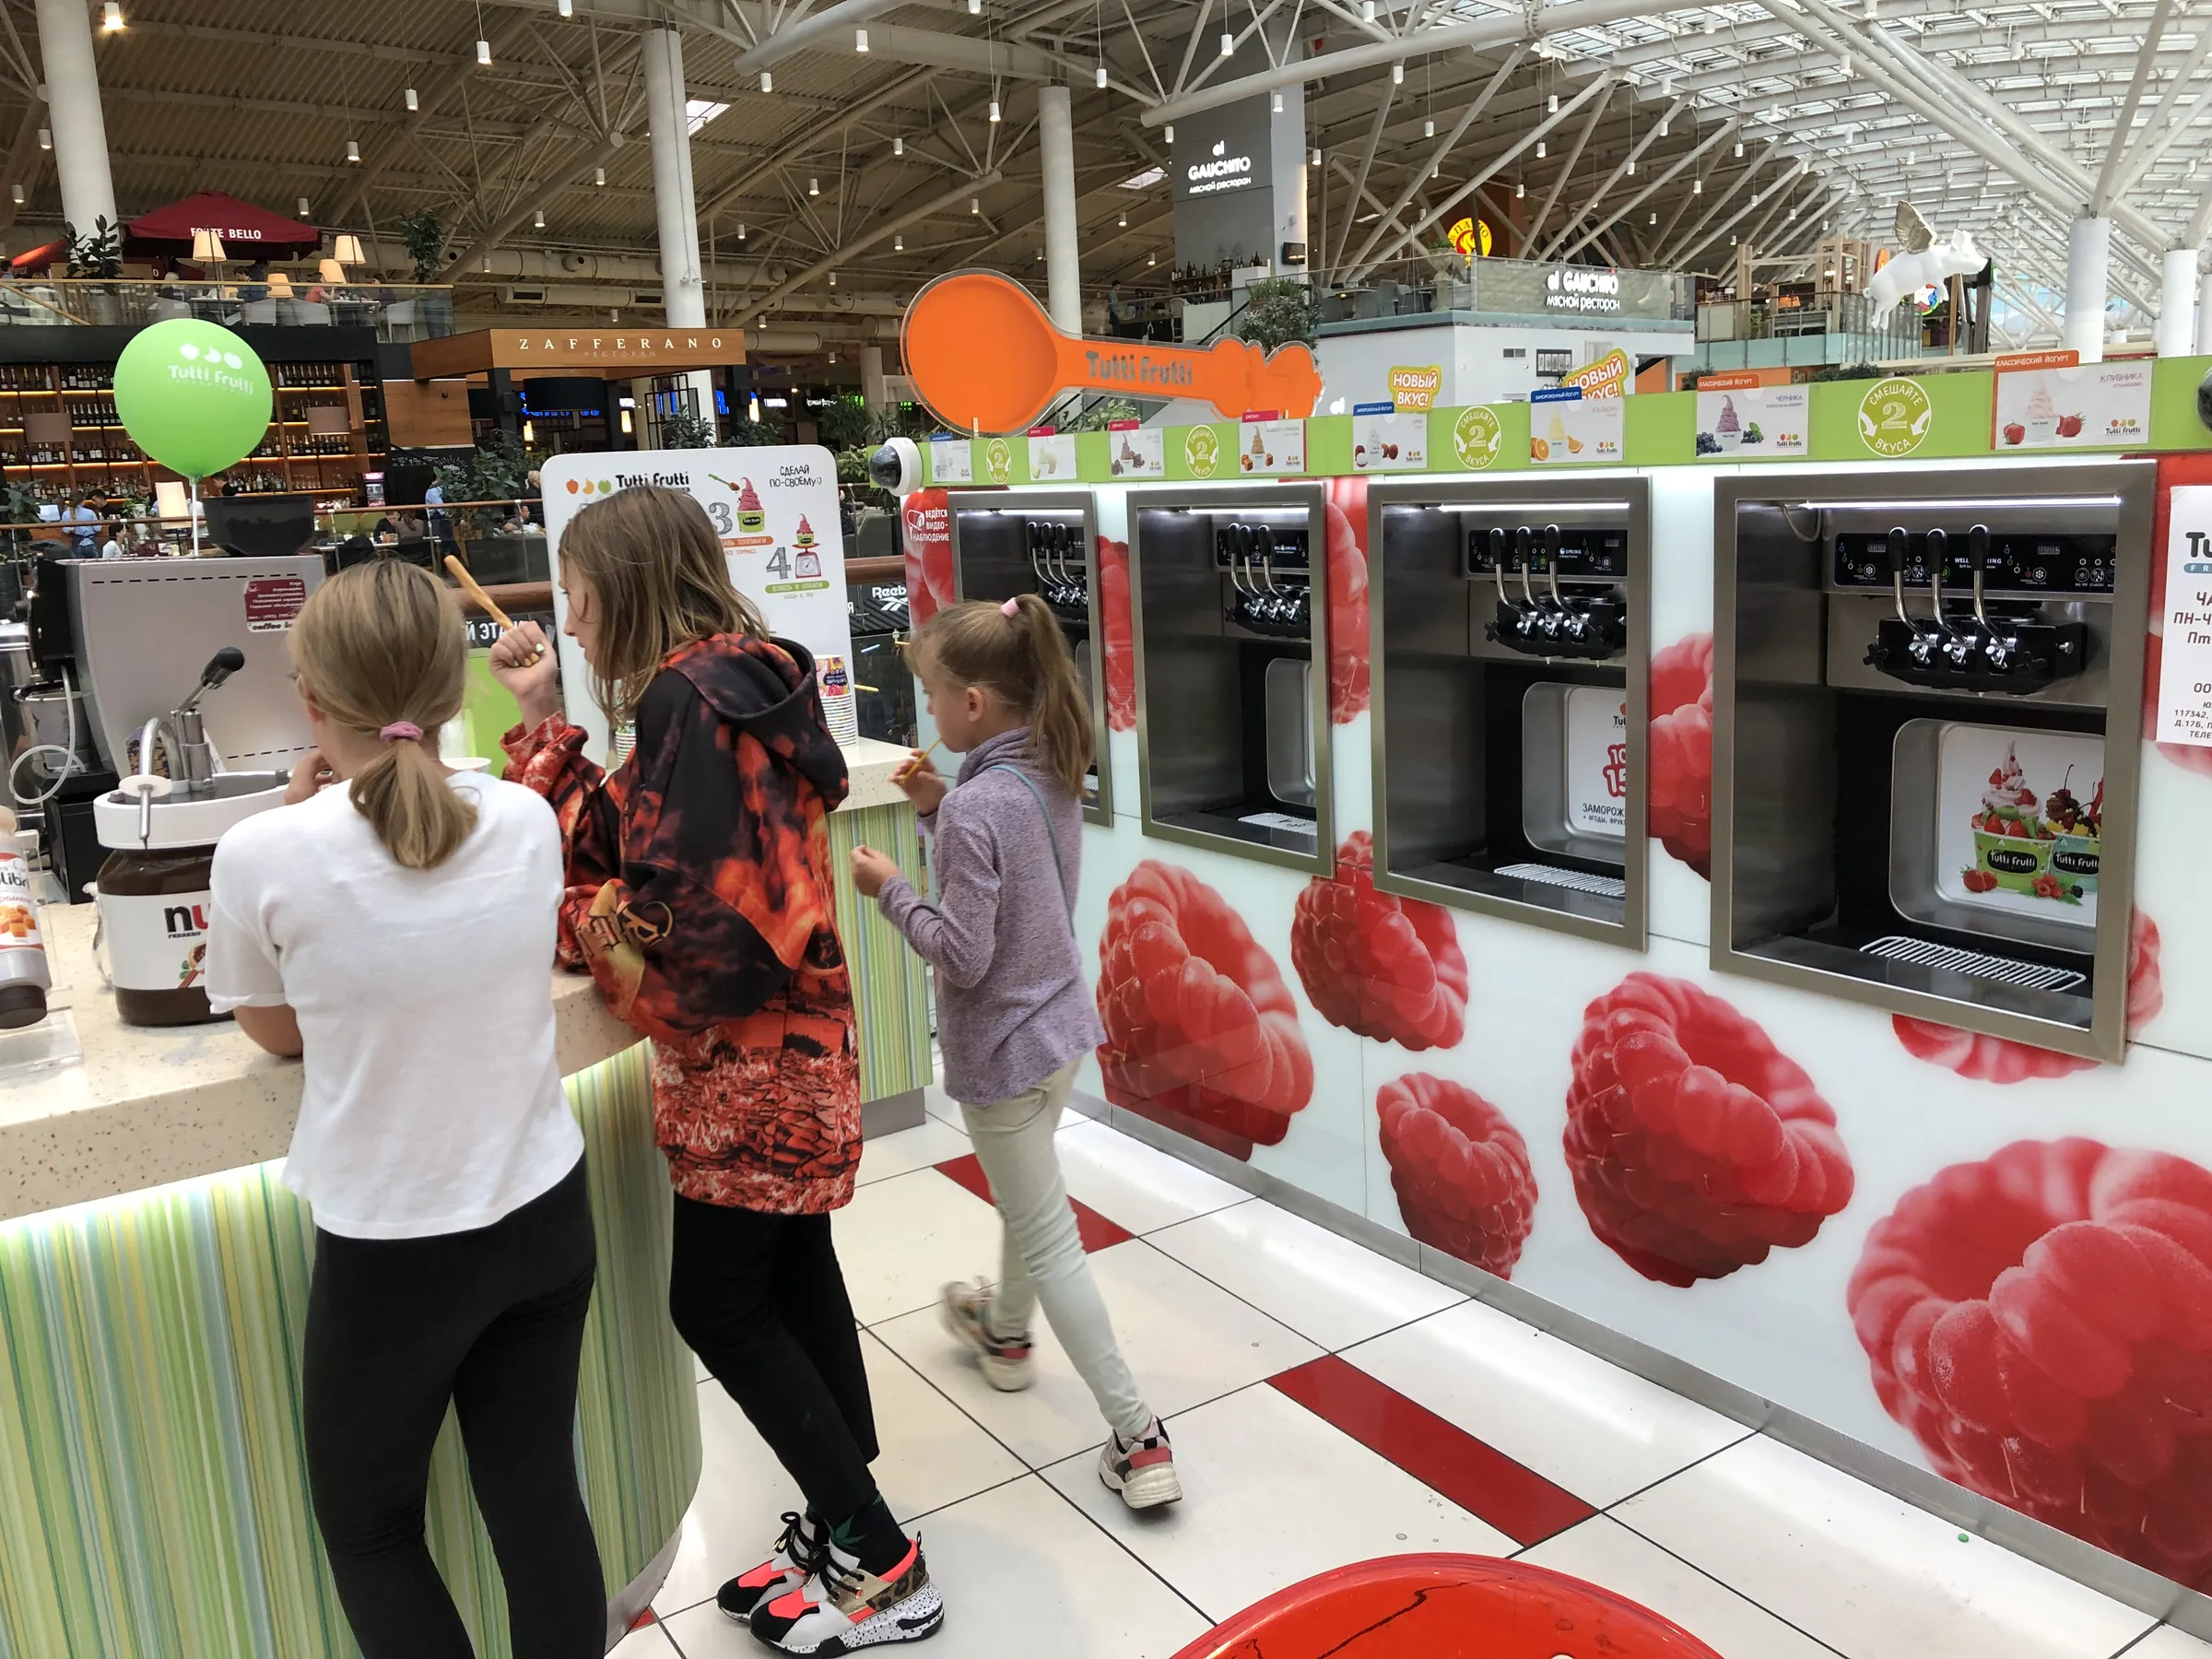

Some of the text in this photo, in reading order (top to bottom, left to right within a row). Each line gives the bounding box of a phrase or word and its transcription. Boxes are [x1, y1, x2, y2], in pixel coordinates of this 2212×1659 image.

[1188, 157, 1251, 181] GAUCHITO
[229, 229, 262, 240] BELLO
[1563, 270, 1619, 295] GAUCHITO
[519, 337, 722, 350] ZAFFERANO
[1085, 350, 1135, 382] Tutti
[1996, 355, 2069, 367] КЛАССИЧЕСКИЙ ЙОГУРТ
[168, 364, 209, 381] Tutti
[1393, 371, 1438, 389] НОВЫЙ
[1569, 356, 1623, 390] НОВЫЙ
[2100, 372, 2143, 382] КЛУБНИКА
[1582, 382, 1619, 400] КУС!
[1869, 383, 1923, 406] СМЕШАЙТЕ
[1397, 392, 1429, 406] ВКУС!
[1460, 410, 1495, 429] СМЕШАЙТЕ
[1881, 401, 1908, 429] 2
[1190, 429, 1215, 444] СМЕШАЙТЕ
[1468, 425, 1487, 448] 2
[1195, 441, 1209, 460] 2
[1875, 438, 1911, 453] ВКУСА
[994, 453, 1005, 467] 2
[1465, 453, 1490, 465] ВКУСА
[780, 465, 810, 477] СДЕЛАЙ
[1194, 465, 1211, 476] ВКУСА
[615, 473, 648, 488] Tutti
[709, 502, 733, 535] 3
[925, 508, 947, 520] ВЕДЁТСЯ
[926, 522, 948, 532] ВИДЕО-
[912, 533, 949, 543] НАБЛЮДЕНИЕ
[766, 547, 791, 580] 4
[1990, 852, 2009, 865] Tutti
[2055, 853, 2074, 865] Tutti
